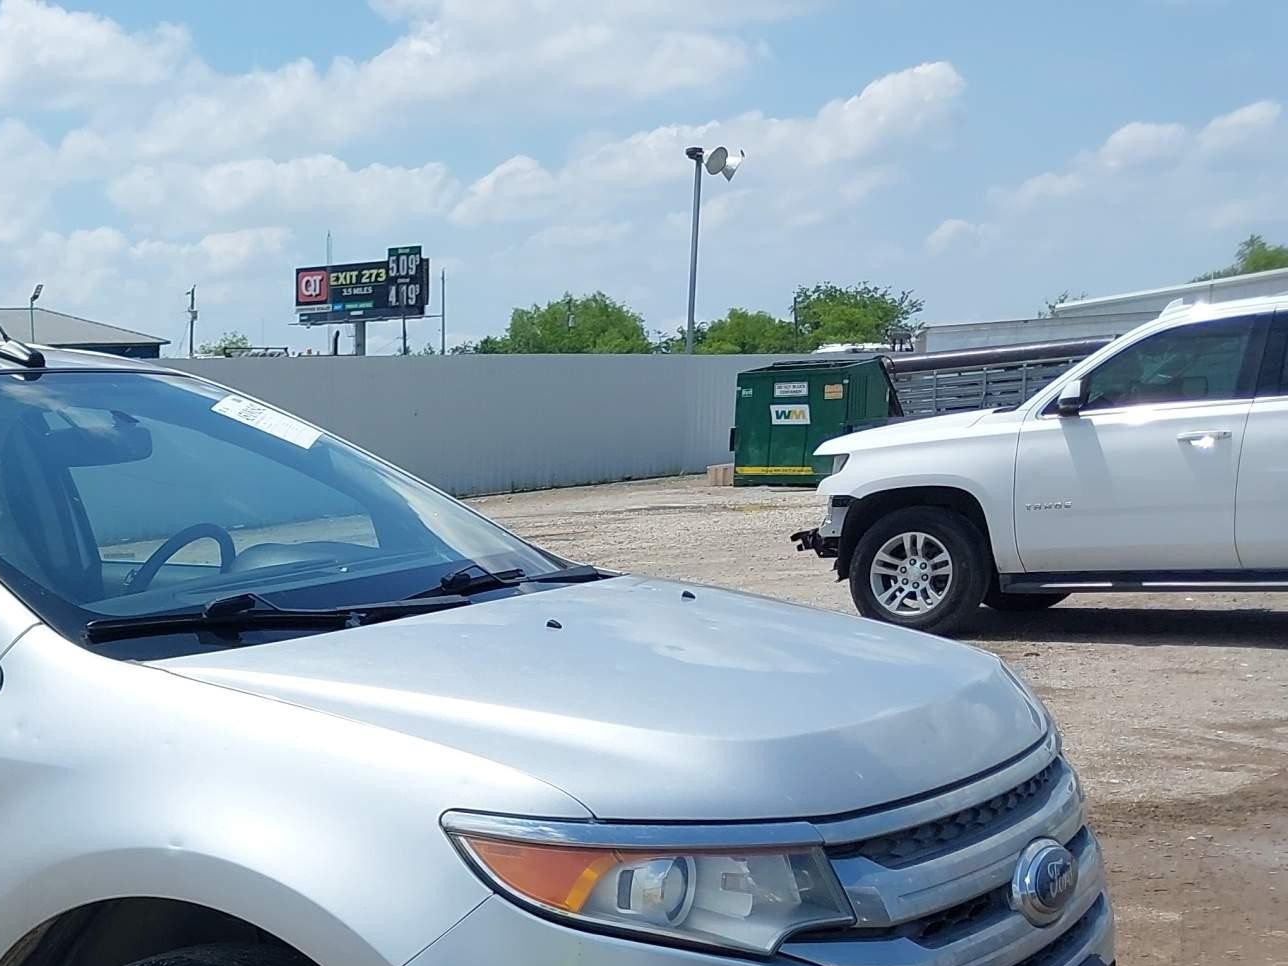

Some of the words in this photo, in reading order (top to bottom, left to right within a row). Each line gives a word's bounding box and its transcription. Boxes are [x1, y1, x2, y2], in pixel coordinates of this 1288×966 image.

[301, 275, 323, 297] QT
[329, 270, 358, 286] EXIT
[361, 268, 386, 283] 273
[775, 410, 806, 420] WM
[1025, 500, 1073, 511] TAHOE
[1047, 857, 1073, 898] Ford
